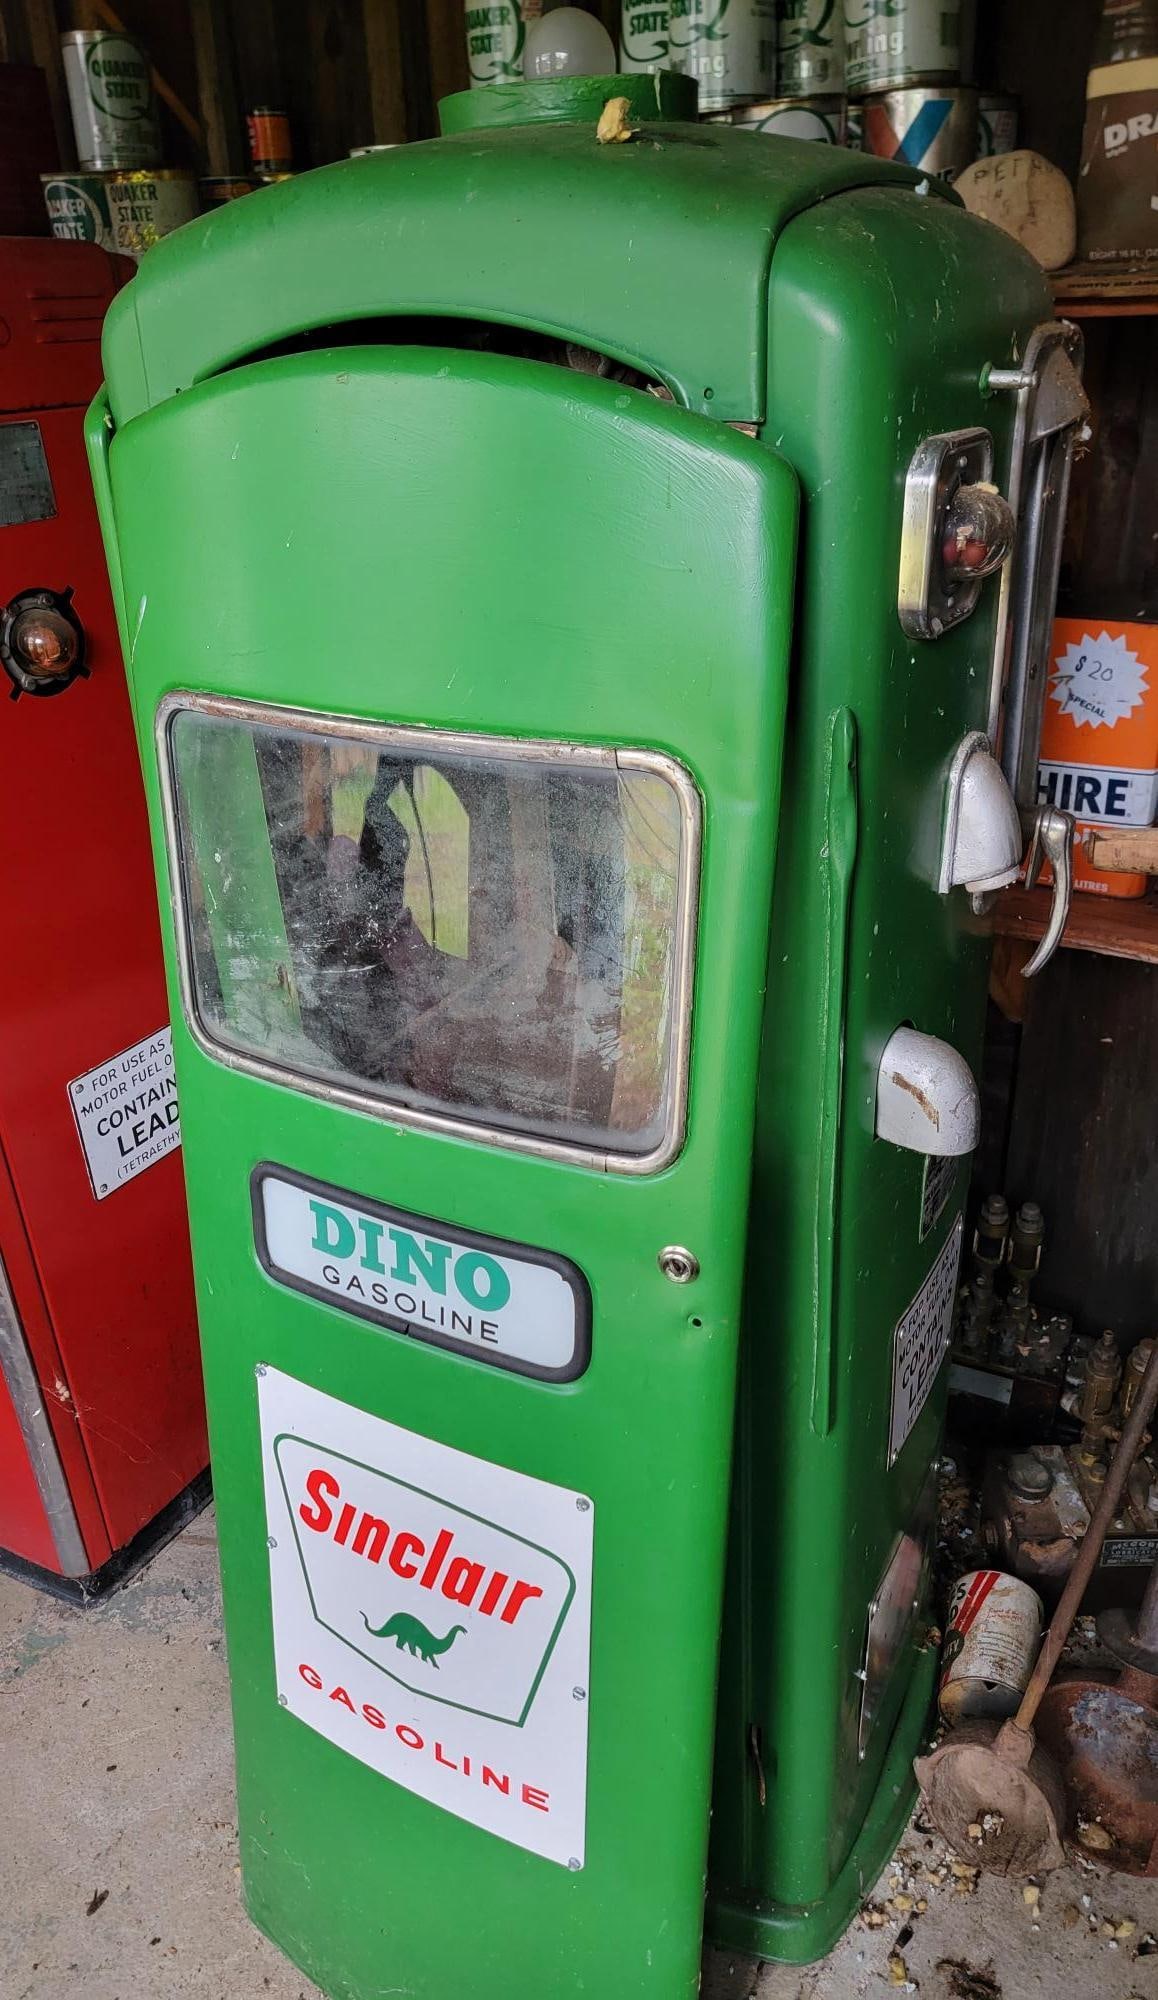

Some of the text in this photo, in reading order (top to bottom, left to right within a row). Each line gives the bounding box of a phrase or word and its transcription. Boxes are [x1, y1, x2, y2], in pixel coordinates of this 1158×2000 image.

[470, 33, 503, 57] STATE
[629, 11, 669, 36] STATE
[106, 82, 141, 99] STATE
[109, 184, 158, 203] QUAKER
[117, 206, 153, 222] STATE
[53, 222, 86, 240] STATE
[1088, 660, 1114, 682] 20
[1068, 691, 1106, 718] SPECIAL
[1036, 770, 1130, 817] HIRE
[1074, 880, 1109, 893] LITRES
[81, 1054, 173, 1117] MOTOR FUEL O
[92, 1038, 165, 1091] FOR USE AS
[97, 1074, 177, 1137] CONTAIN
[117, 1100, 180, 1157] LEAD
[117, 1129, 182, 1179] (TETRAETHY
[309, 1199, 511, 1312] DINO
[322, 1264, 499, 1344] GASOLINE
[908, 1324, 944, 1410] LEAD
[300, 1469, 544, 1625] Sinclair
[298, 1663, 550, 1813] GASOLINE
